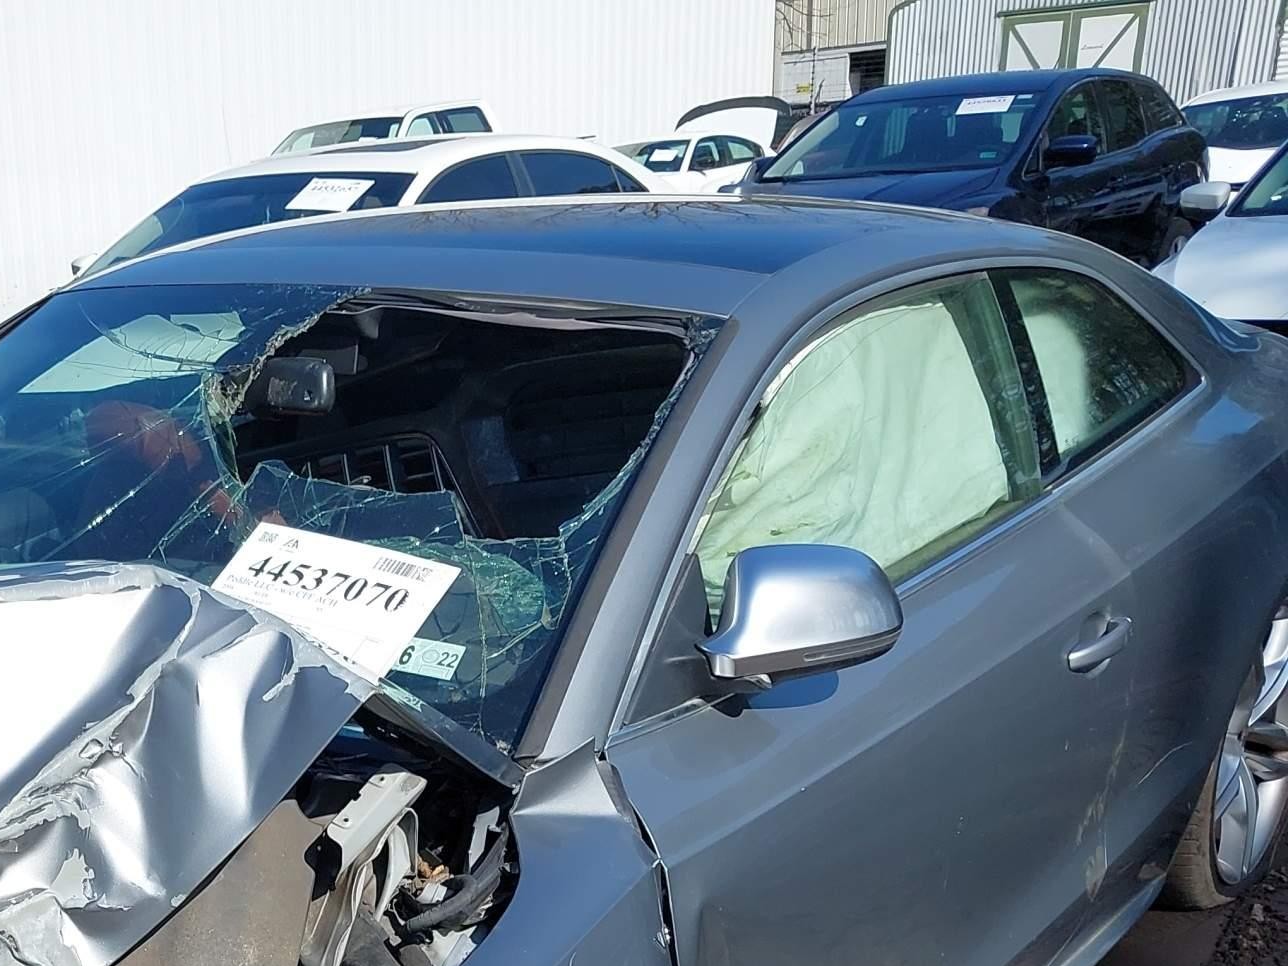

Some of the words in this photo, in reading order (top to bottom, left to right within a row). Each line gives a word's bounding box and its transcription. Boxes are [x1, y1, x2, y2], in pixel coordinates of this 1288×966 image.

[248, 556, 409, 611] 44537070
[398, 645, 415, 665] 6
[436, 652, 459, 669] 22
